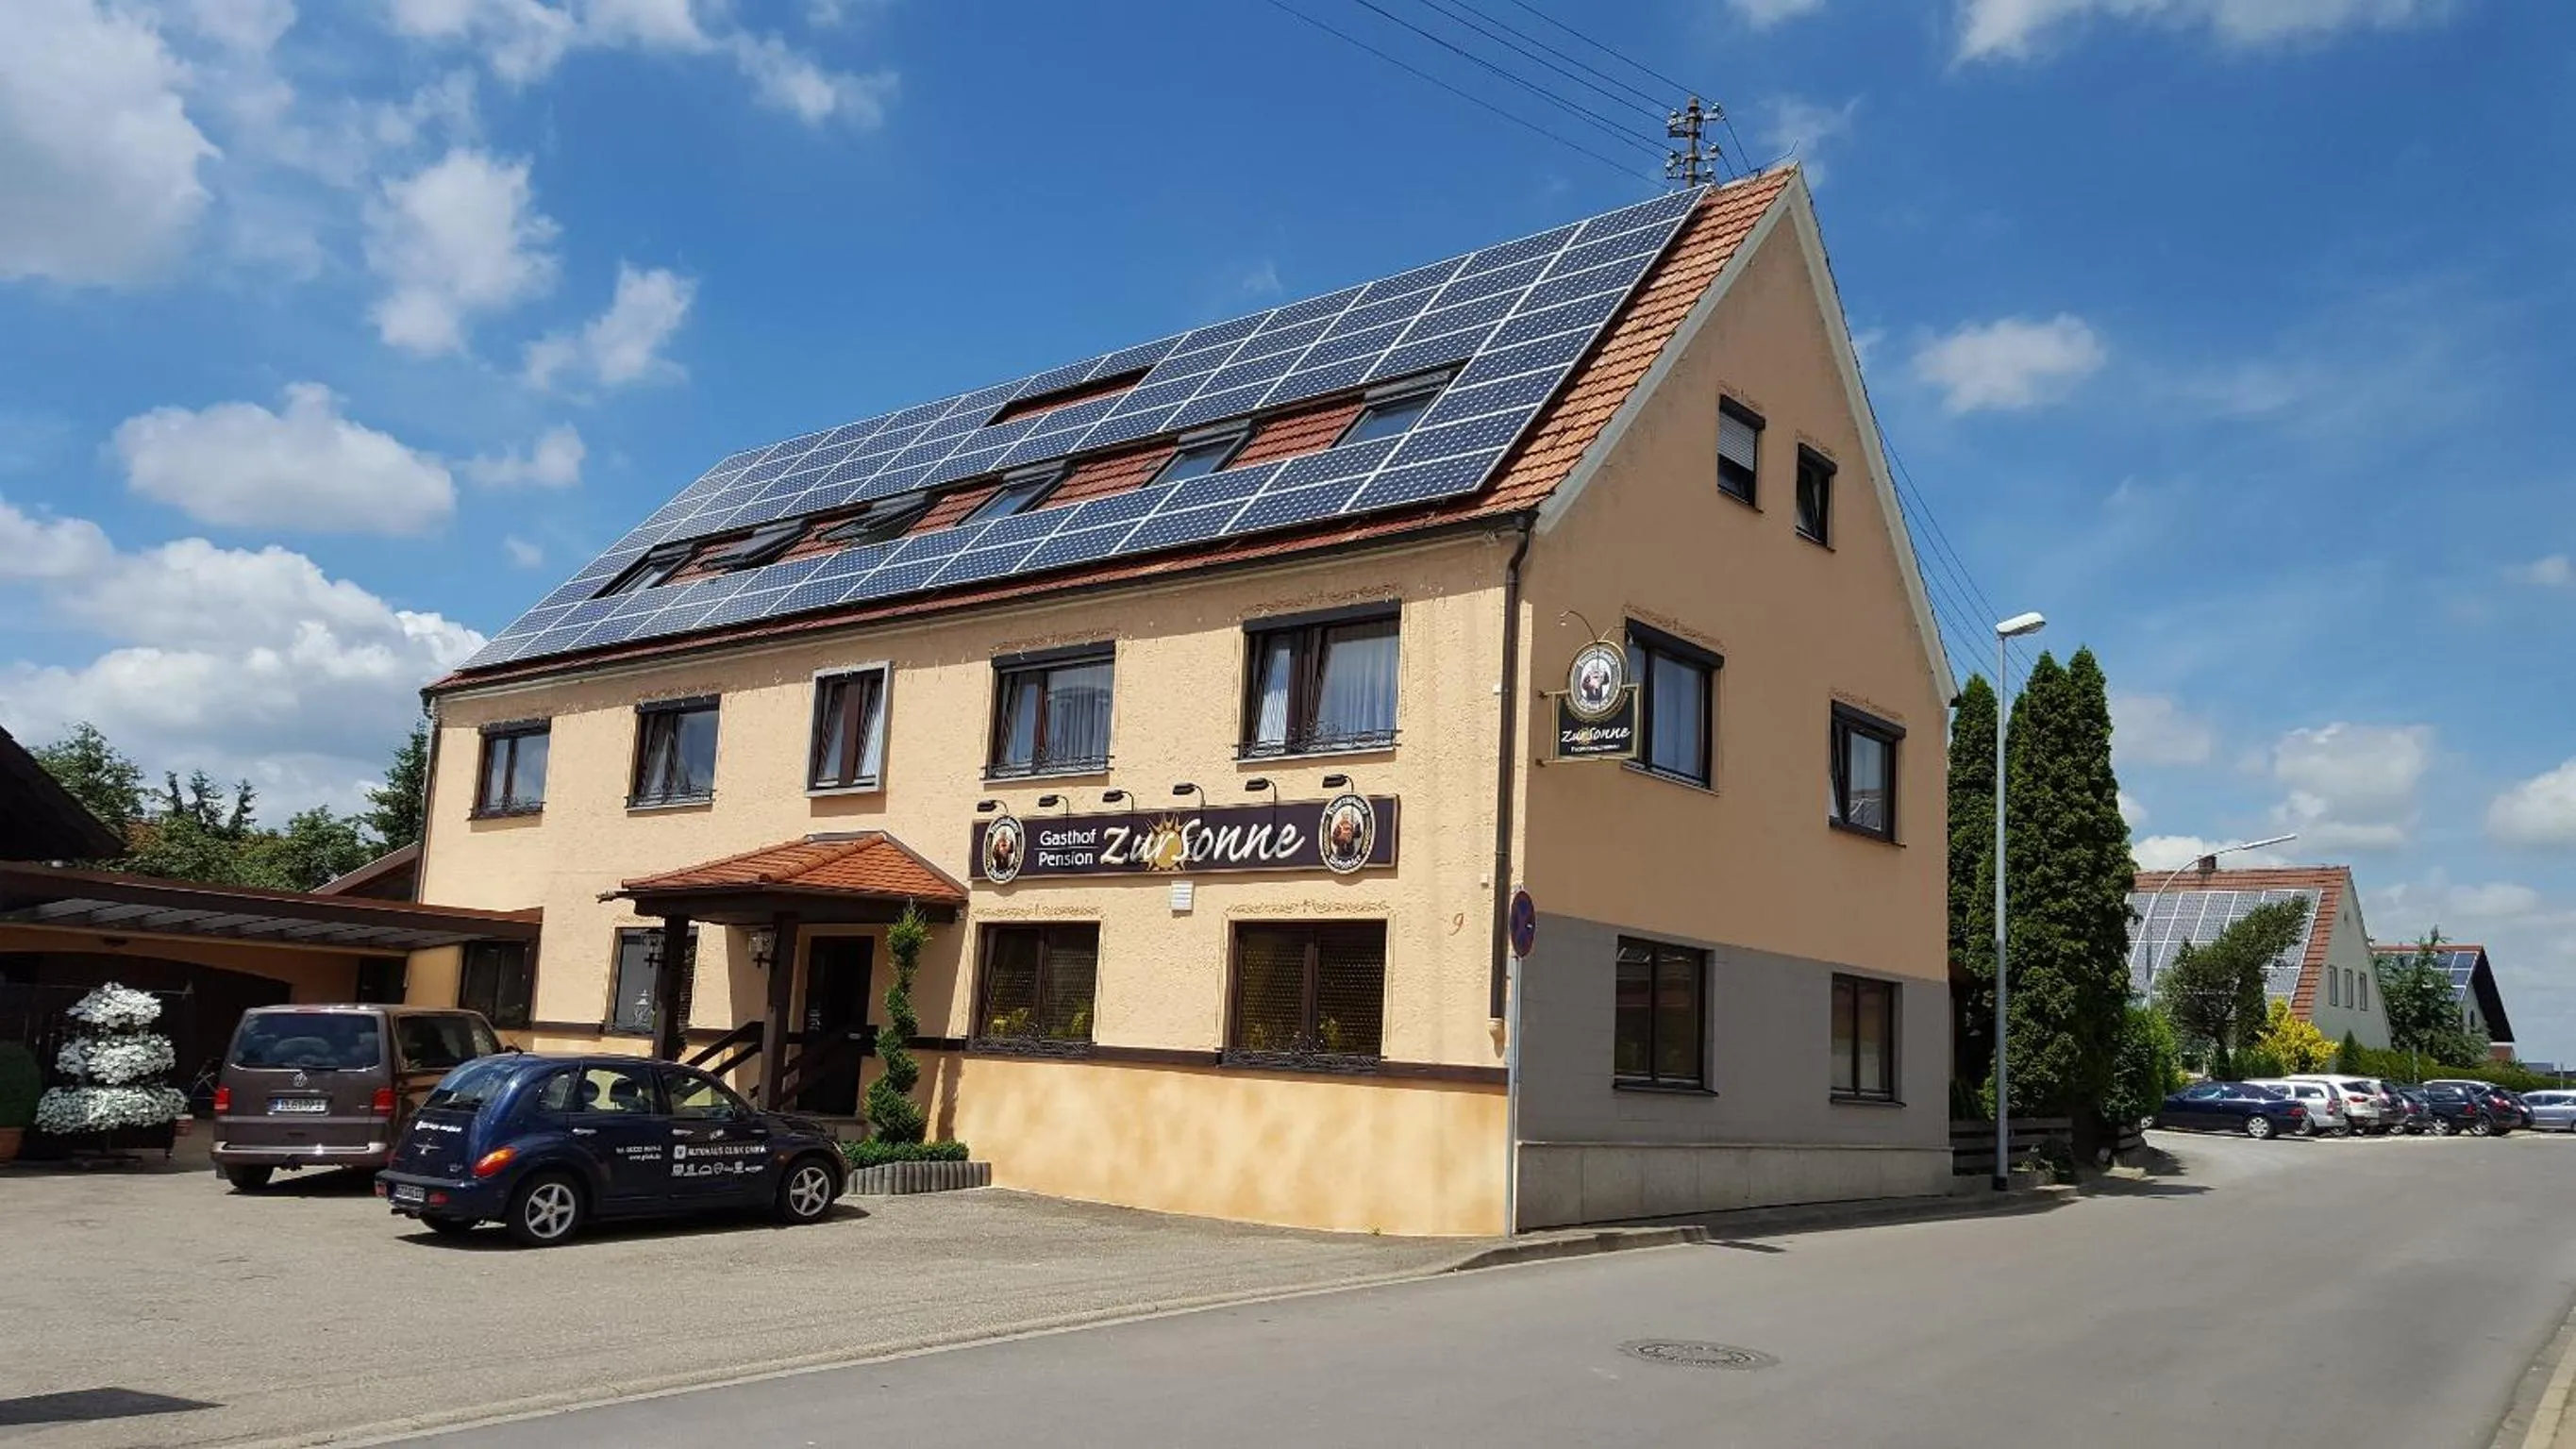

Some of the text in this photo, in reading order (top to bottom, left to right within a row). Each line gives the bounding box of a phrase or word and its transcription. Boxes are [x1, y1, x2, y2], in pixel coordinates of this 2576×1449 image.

[1040, 828, 1096, 846] Gasthof
[1099, 817, 1306, 865] Zur Sonne
[1038, 851, 1094, 867] Pension
[1447, 912, 1464, 937] 9
